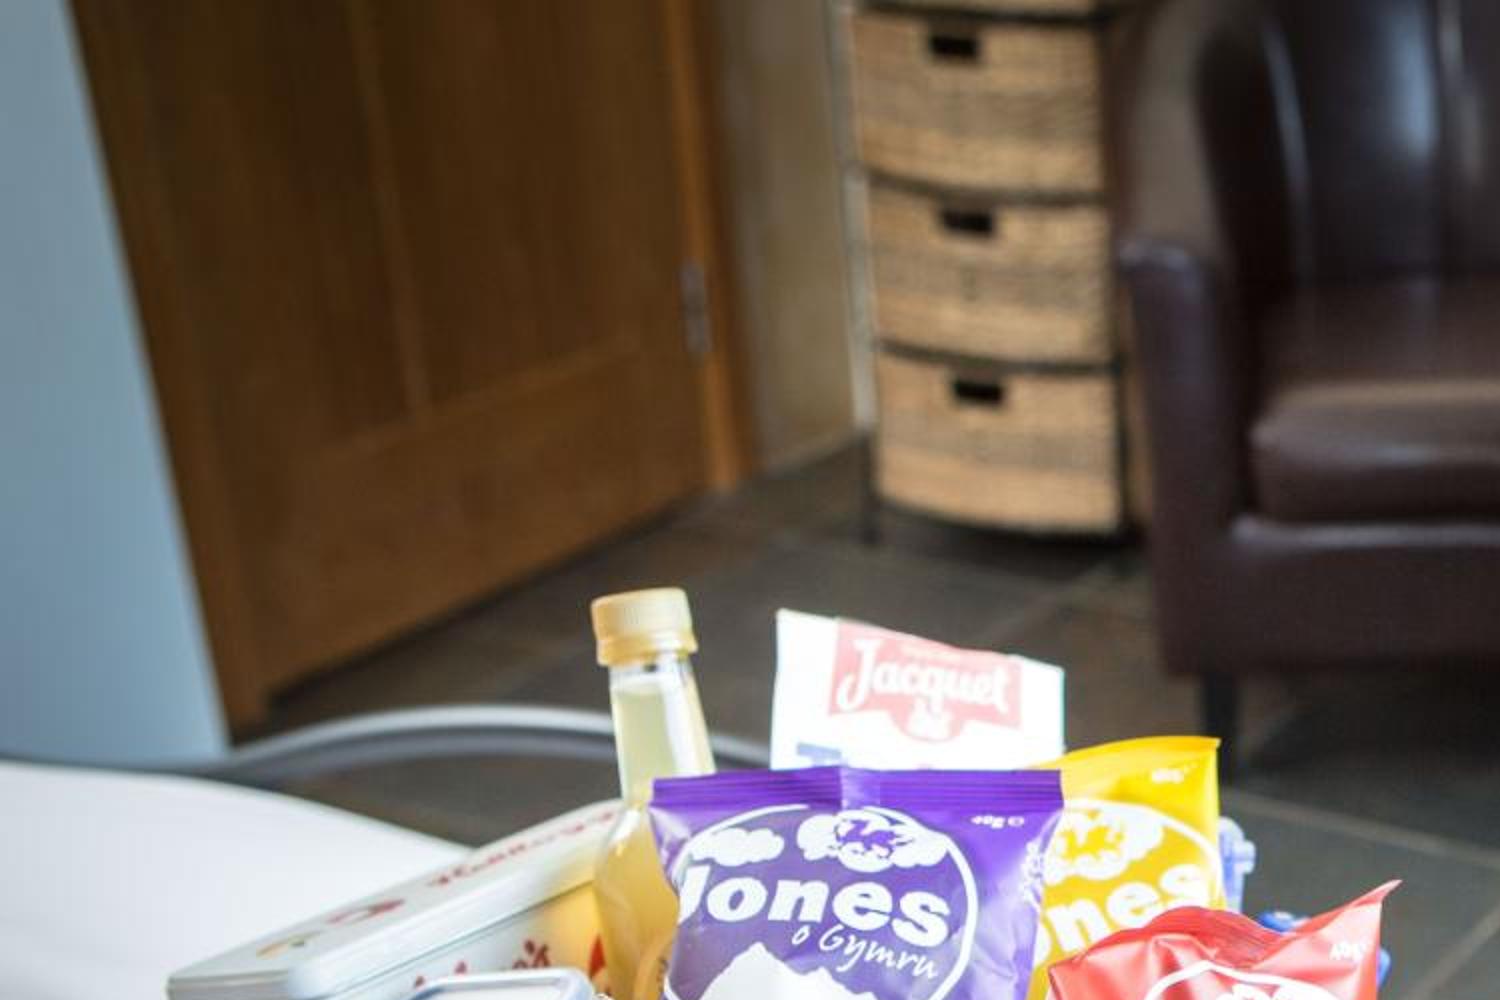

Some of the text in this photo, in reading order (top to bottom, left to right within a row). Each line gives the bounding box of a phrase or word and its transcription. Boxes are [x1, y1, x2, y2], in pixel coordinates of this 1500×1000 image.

[836, 638, 1010, 717] Jacquet
[678, 865, 951, 948] Jones
[818, 923, 940, 980] Gymru
